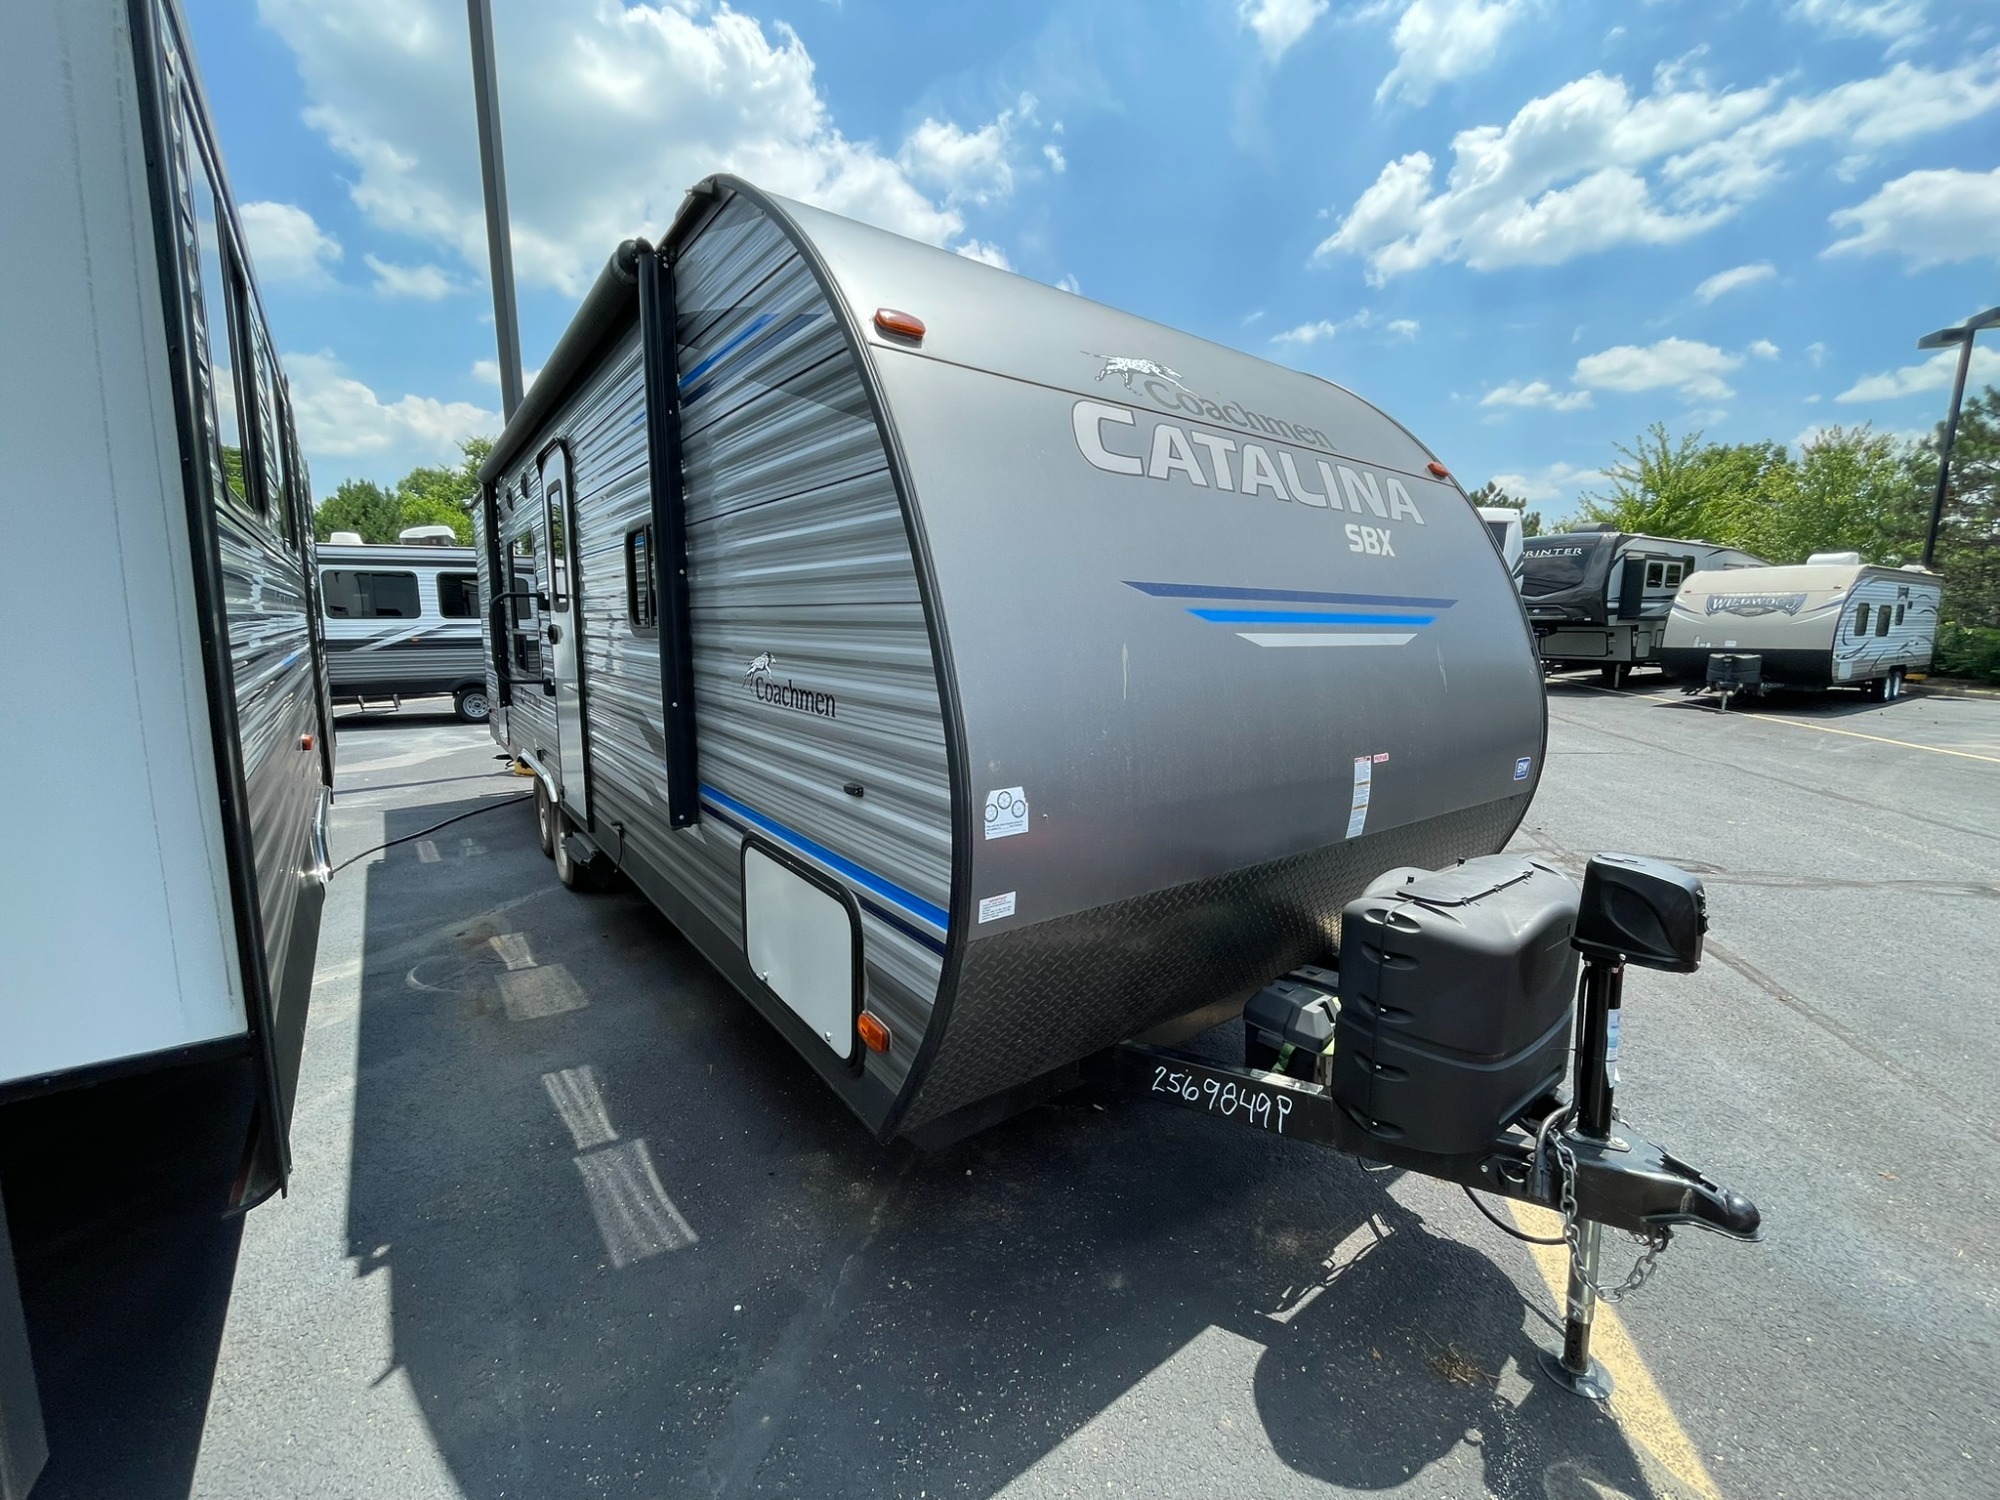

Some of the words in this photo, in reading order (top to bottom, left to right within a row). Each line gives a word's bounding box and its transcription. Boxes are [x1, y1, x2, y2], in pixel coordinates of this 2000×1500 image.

[1144, 378, 1337, 451] Coachmen
[1071, 399, 1427, 526] CATALINA
[1345, 523, 1396, 557] SBX
[1523, 547, 1583, 558] RINTER
[755, 676, 836, 717] Coachmen
[1151, 1065, 1293, 1134] 2569849P
